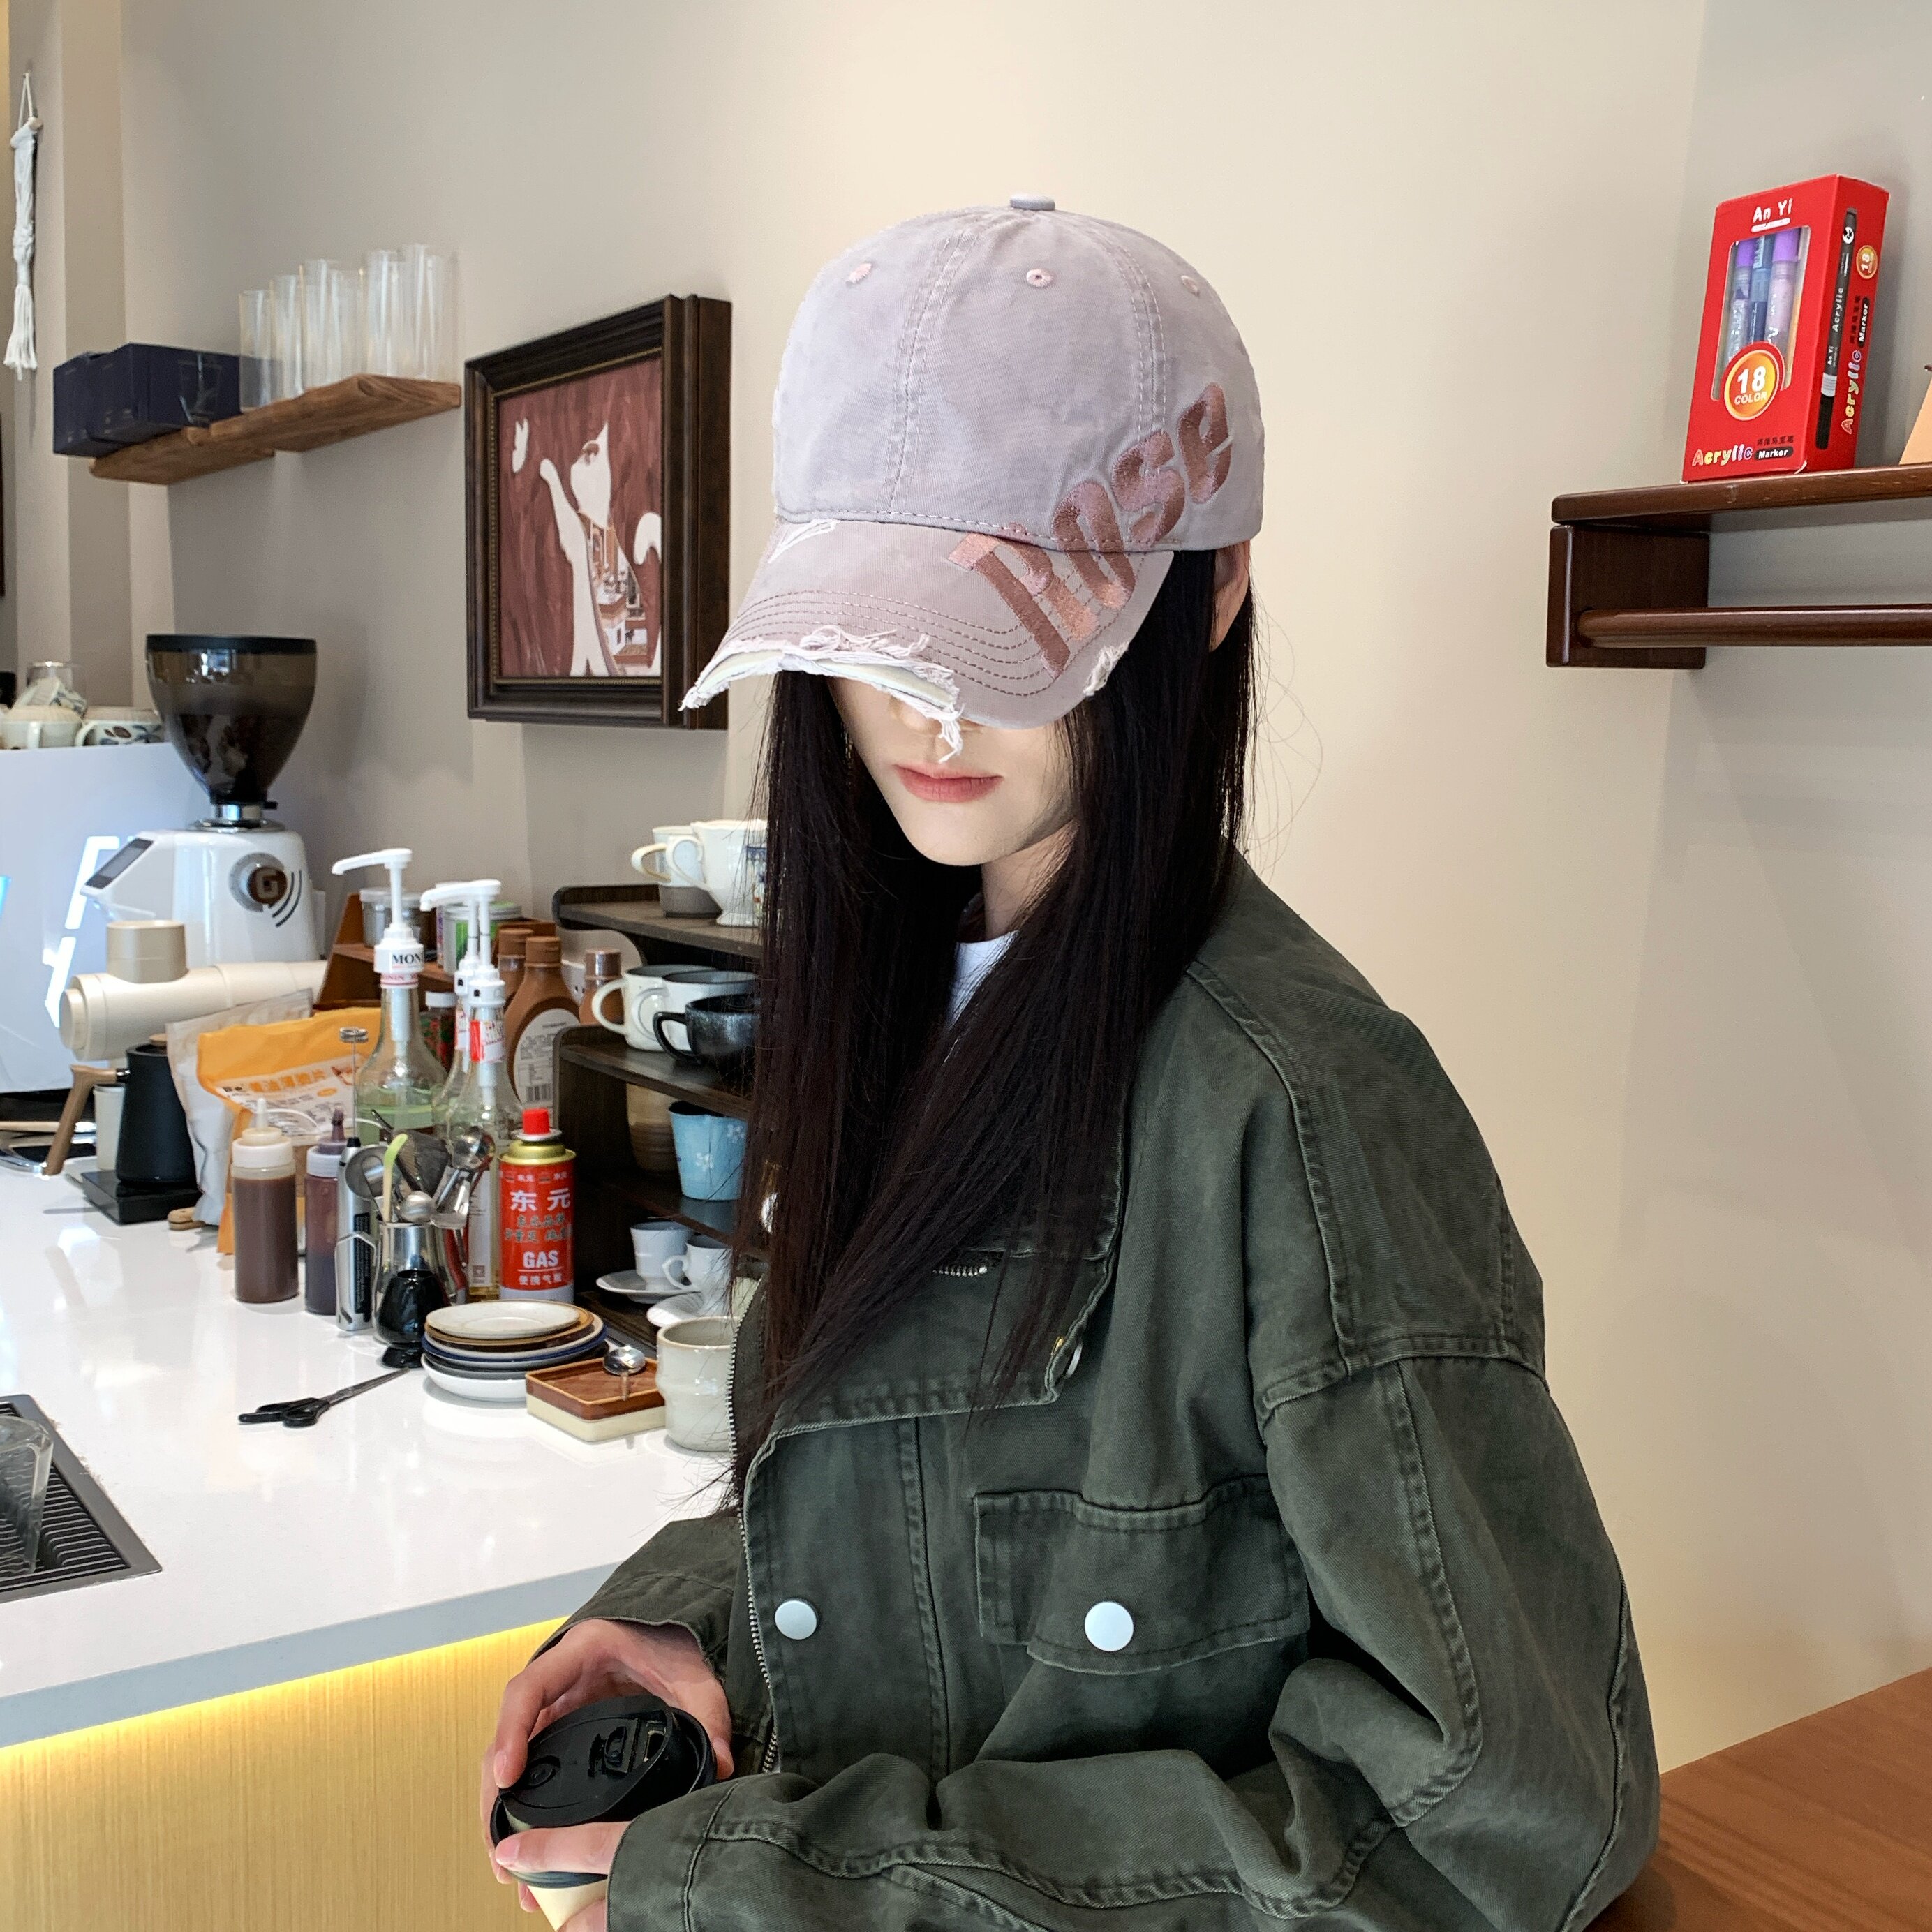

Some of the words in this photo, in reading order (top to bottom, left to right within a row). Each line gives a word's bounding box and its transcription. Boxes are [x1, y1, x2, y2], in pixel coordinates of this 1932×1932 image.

[1752, 207, 1771, 223] An
[1778, 198, 1793, 216] Yi
[1832, 288, 1843, 332] Acrylic
[1859, 304, 1868, 342] Marker
[1737, 366, 1767, 394] 18
[1841, 350, 1862, 435] Acrylic
[1734, 391, 1767, 405] COLOR
[1692, 444, 1753, 466] Acrylic
[1758, 449, 1789, 459] Marker
[510, 1188, 571, 1212] 东元
[523, 1250, 558, 1268] GAS
